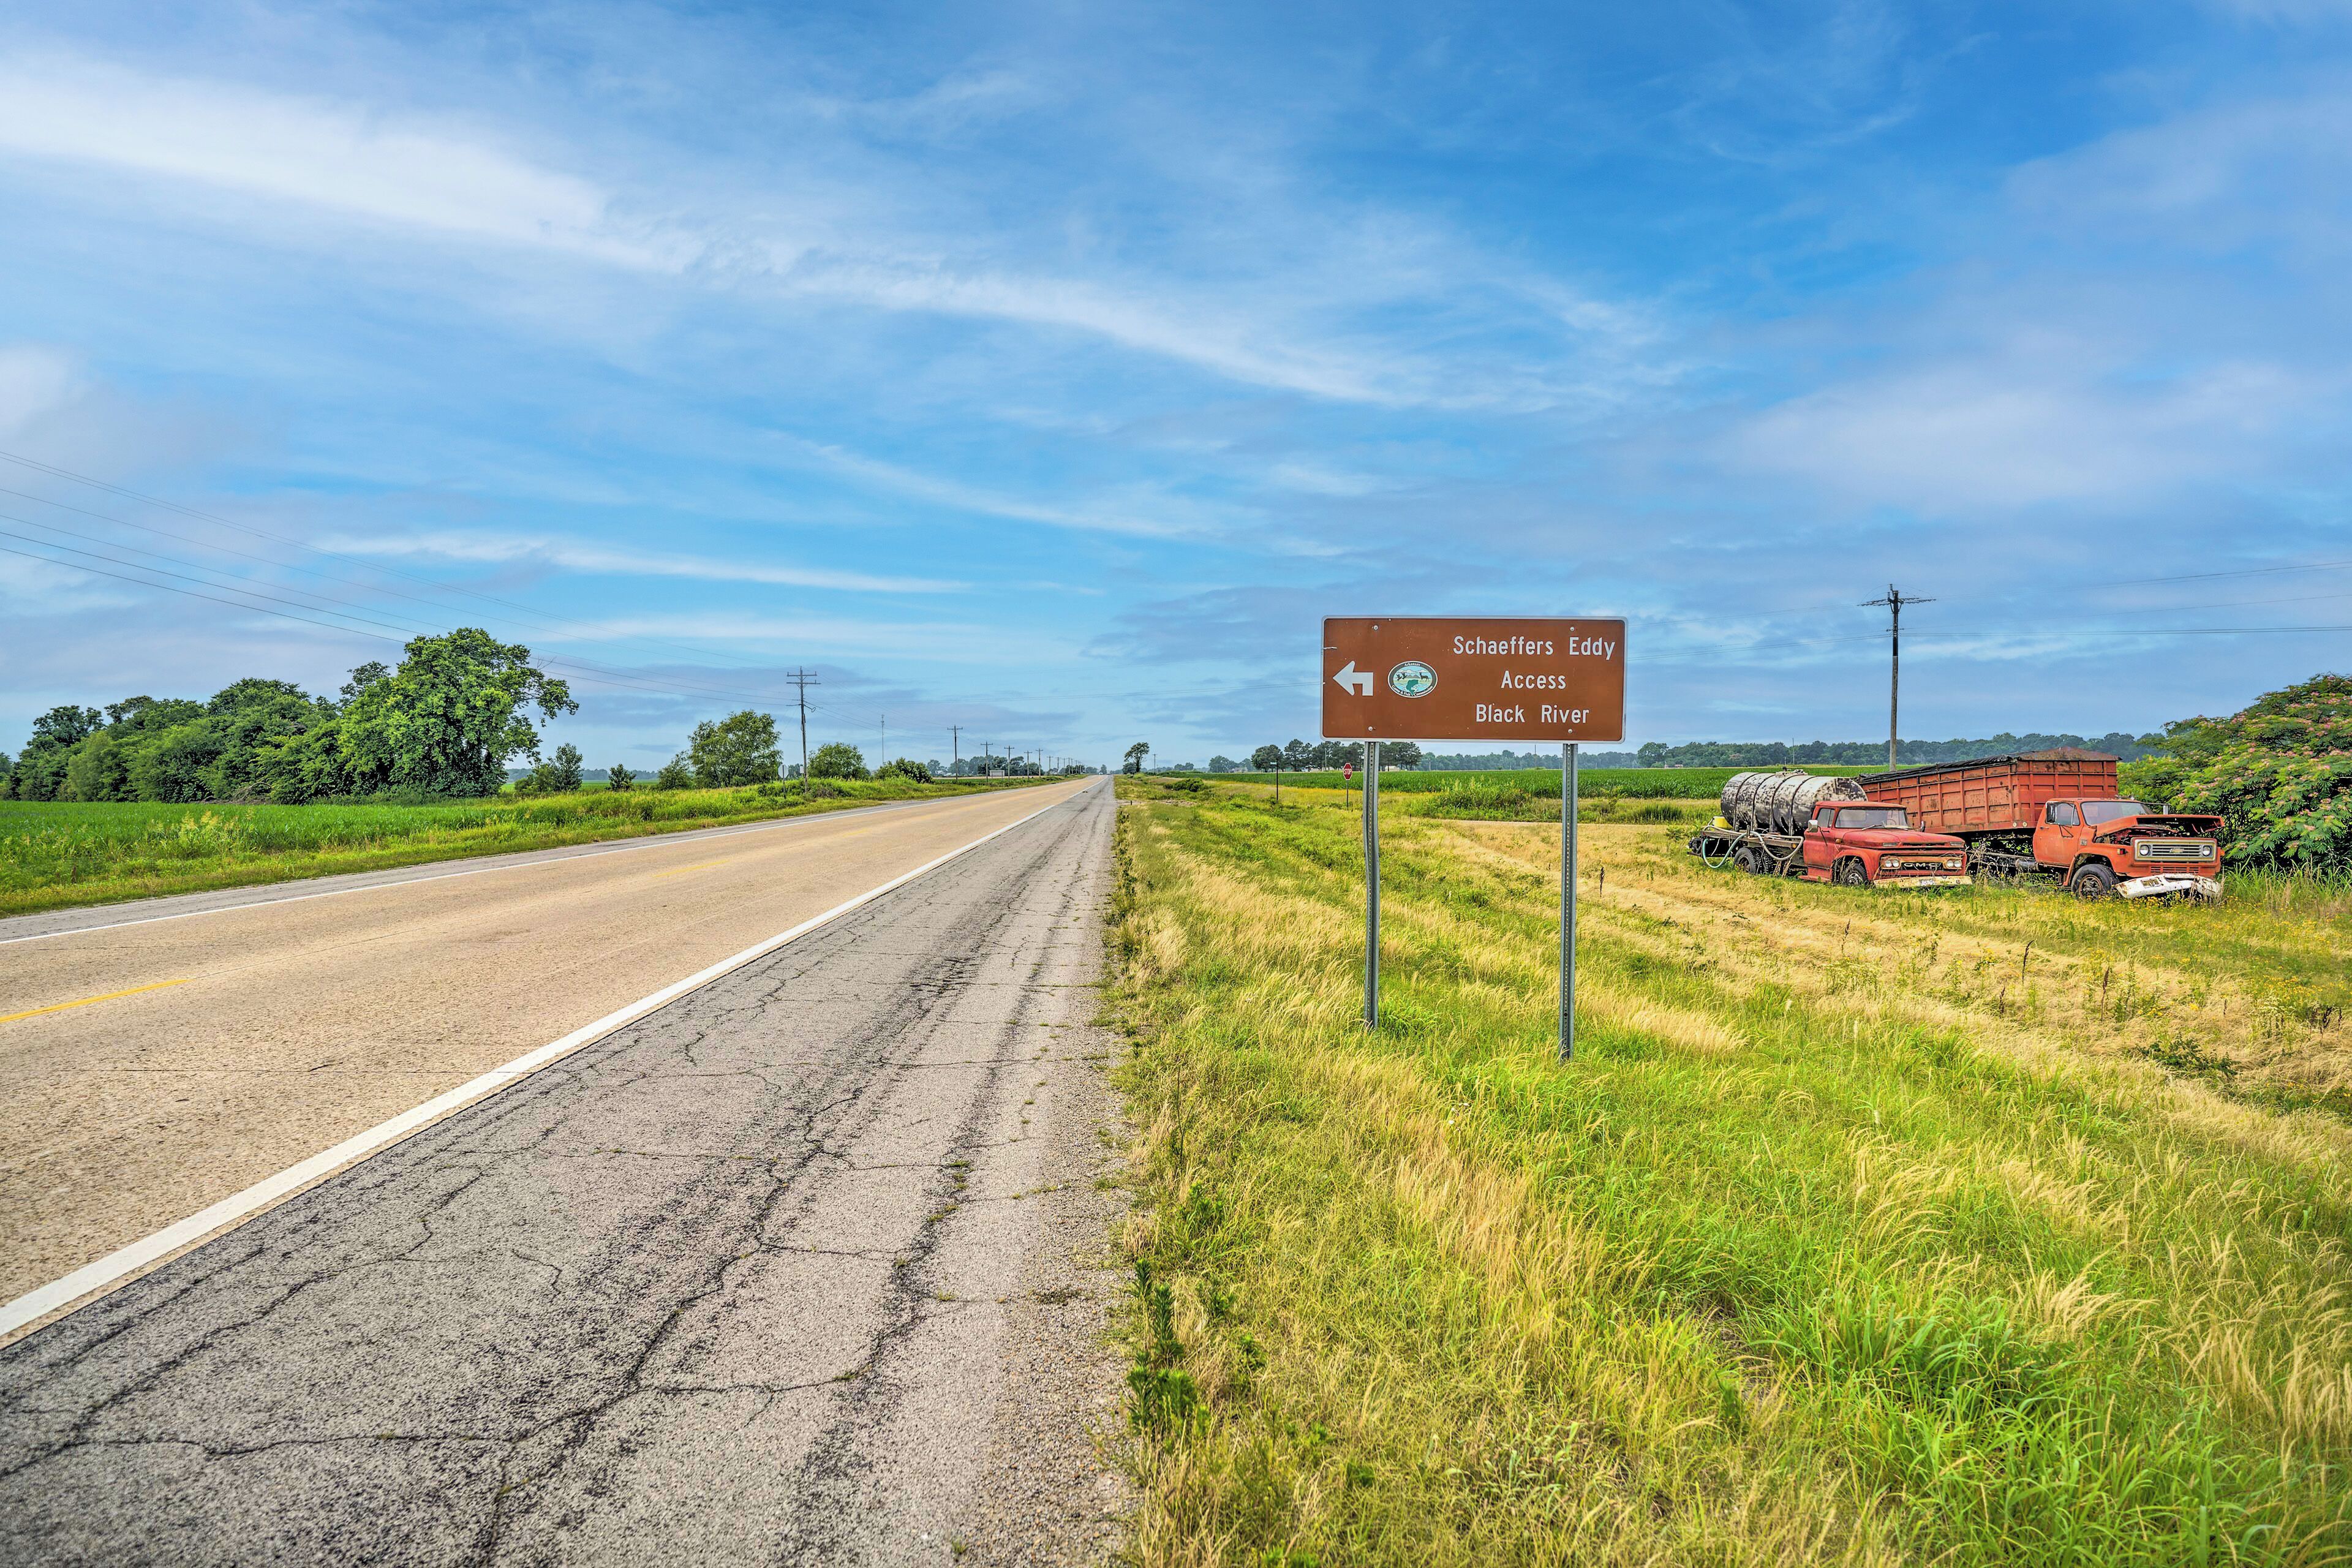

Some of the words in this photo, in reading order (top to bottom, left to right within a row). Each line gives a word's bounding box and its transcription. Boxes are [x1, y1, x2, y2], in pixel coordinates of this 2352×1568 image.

[1453, 635, 1554, 655] Schaeffers
[1569, 636, 1616, 660] Eddy
[1501, 670, 1566, 690] Access
[1476, 704, 1525, 723] Black
[1541, 704, 1589, 723] River
